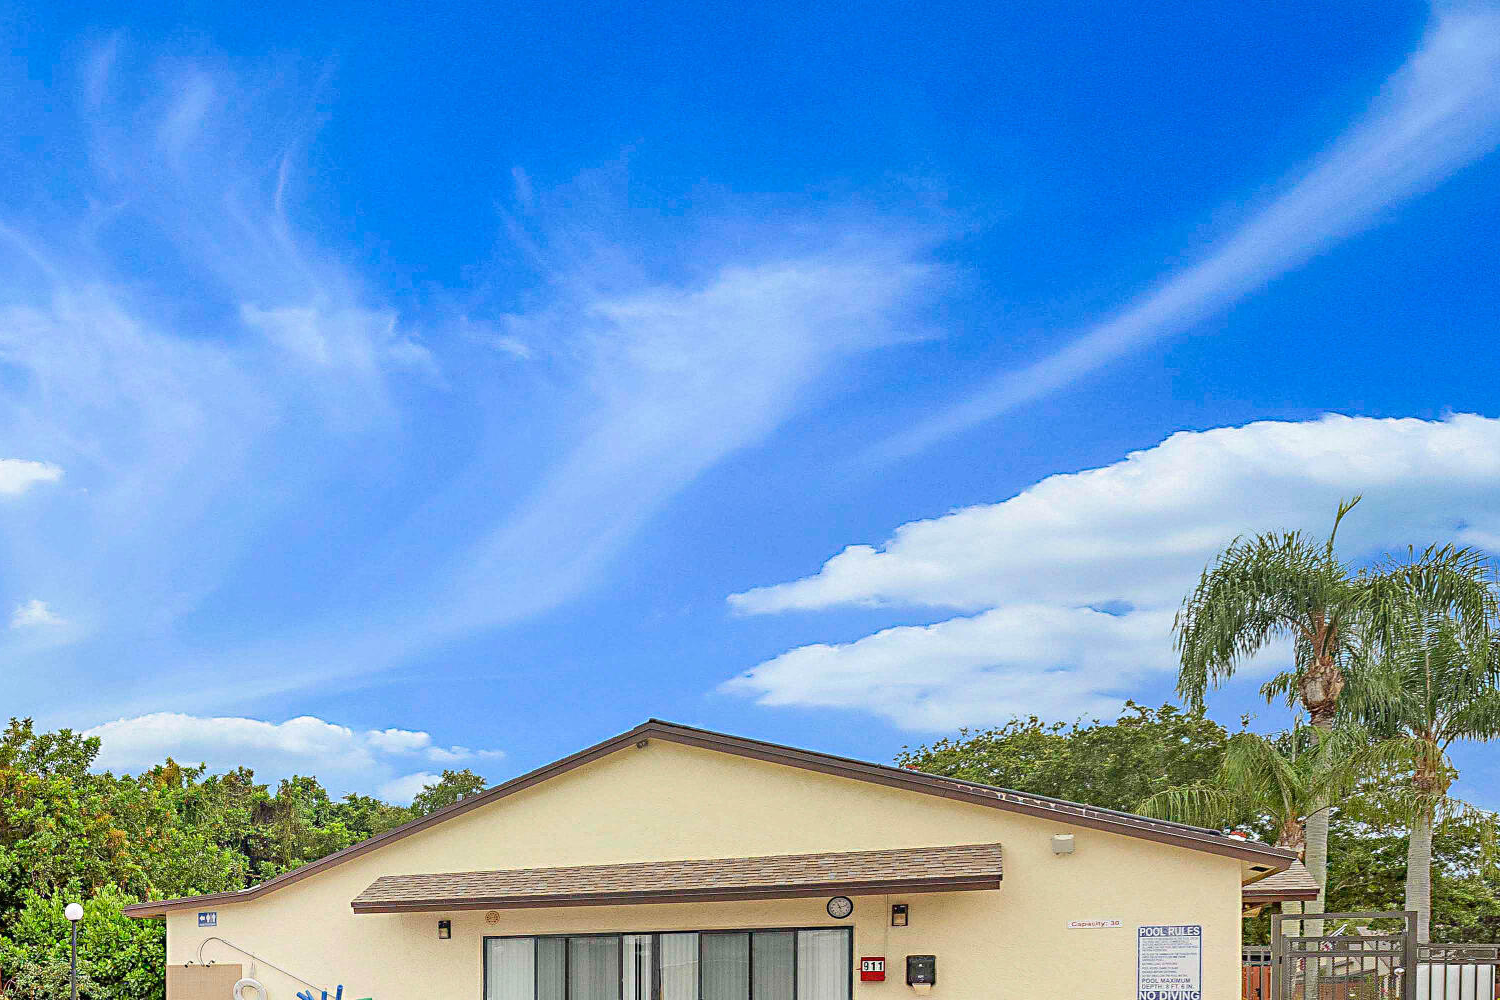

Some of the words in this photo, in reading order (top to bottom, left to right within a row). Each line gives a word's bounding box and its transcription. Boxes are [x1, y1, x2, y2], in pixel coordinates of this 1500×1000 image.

[1139, 927, 1167, 937] POOL
[1168, 926, 1200, 936] RULES
[863, 961, 883, 971] 911
[1138, 991, 1157, 1000] NO
[1159, 991, 1201, 1000] DIVING
